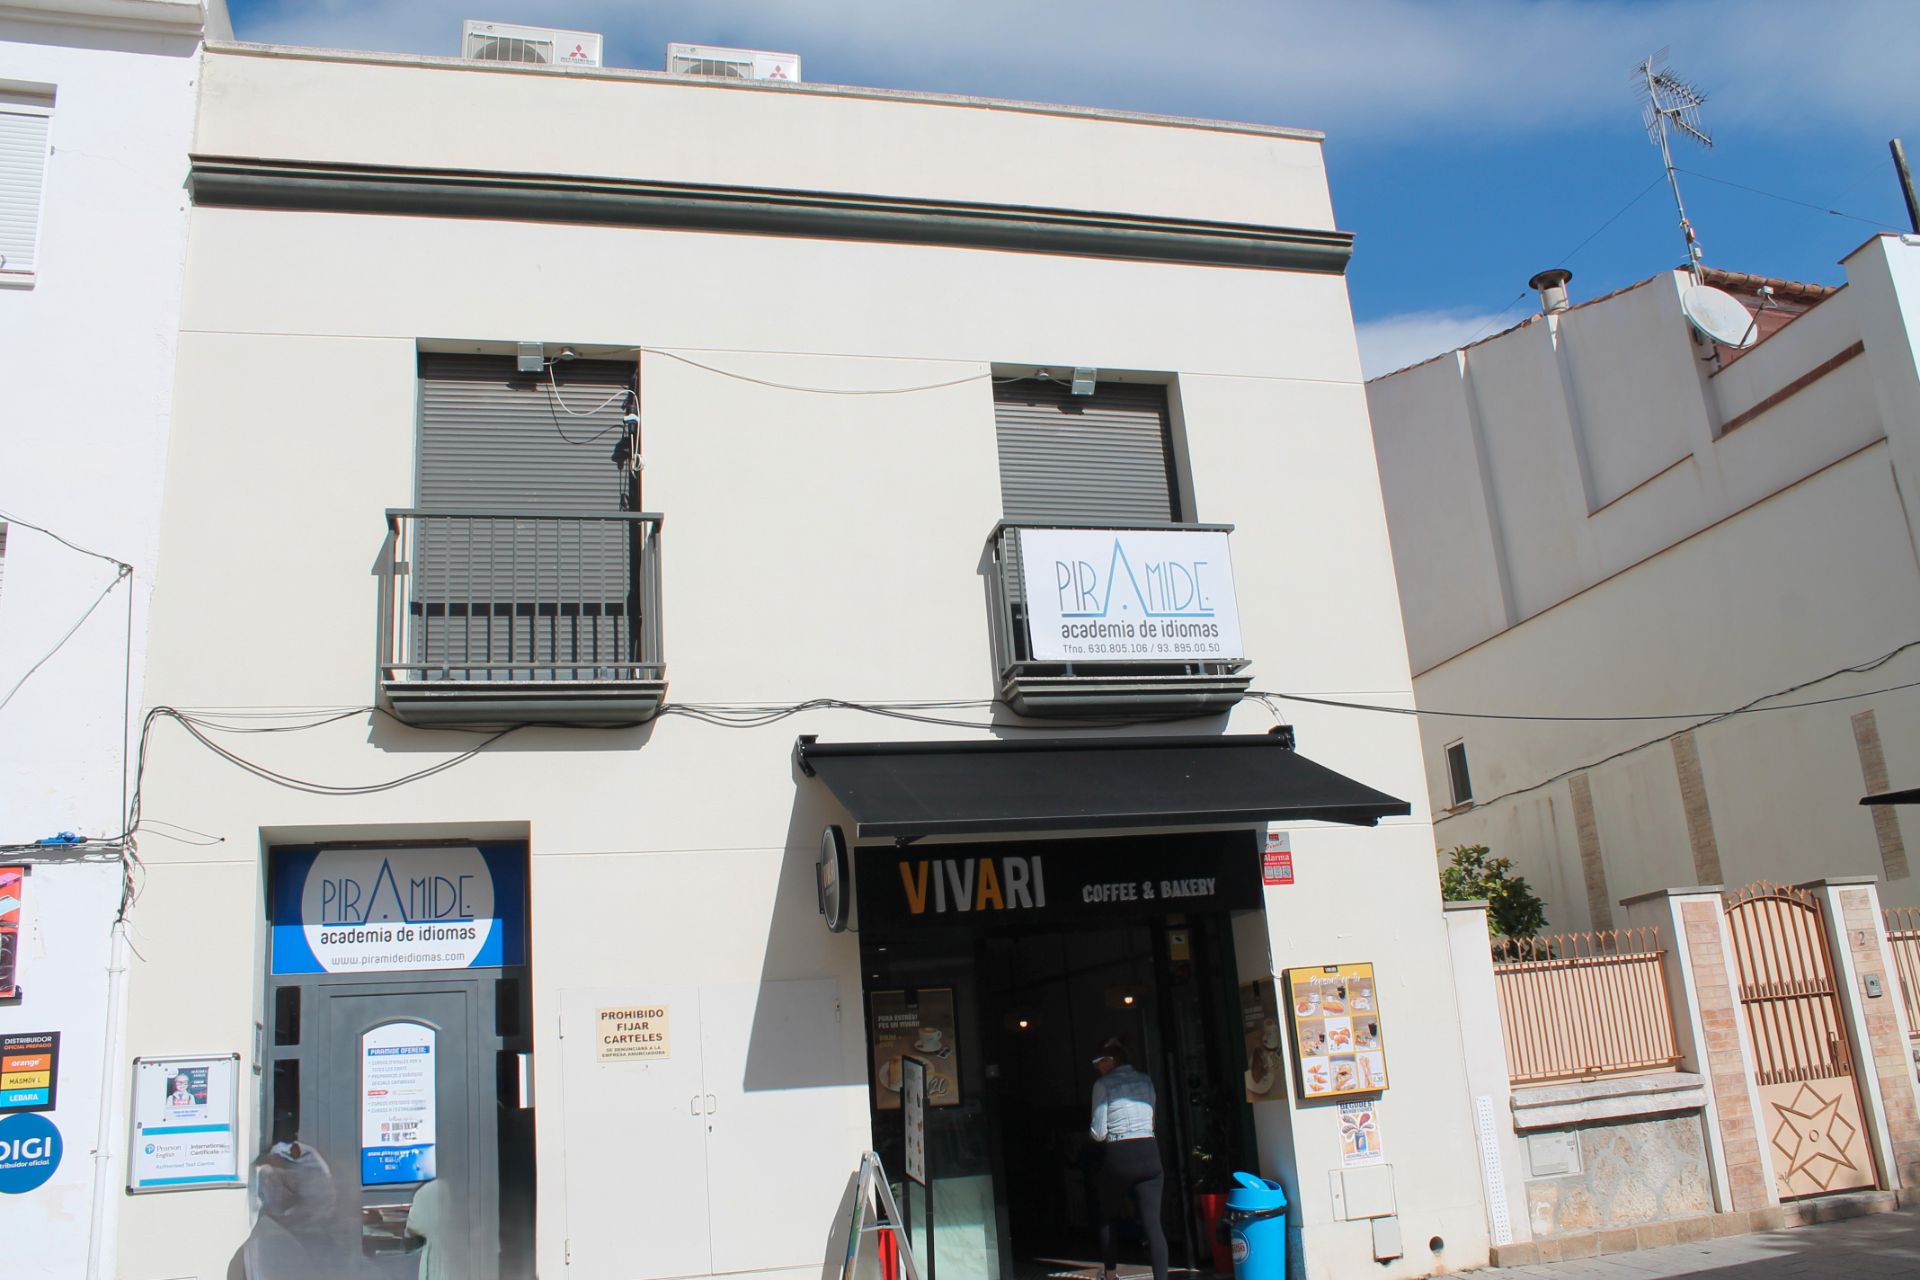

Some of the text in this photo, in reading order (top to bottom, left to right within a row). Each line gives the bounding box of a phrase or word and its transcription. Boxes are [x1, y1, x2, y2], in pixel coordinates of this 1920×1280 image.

[1061, 620, 1219, 638] academia de idiomas
[1063, 643, 1086, 654] Tfno.
[1088, 643, 1148, 654] 630.805.106
[1174, 643, 1220, 653] 895.00.50
[899, 856, 1216, 914] VIVARI COFFEE & BAKERY
[321, 926, 476, 945] academia de idiomas
[331, 951, 466, 966] www.piramideidiomas.com
[601, 1009, 664, 1020] PROHIBIDO
[617, 1022, 649, 1031] FIJAR
[5, 1036, 52, 1045] DISTRIBUIDOR
[604, 1033, 663, 1044] CARTELES
[11, 1058, 40, 1067] orange
[9, 1093, 39, 1102] LEBARA
[156, 1144, 182, 1152] Pearson
[29, 1159, 50, 1167] oficial
